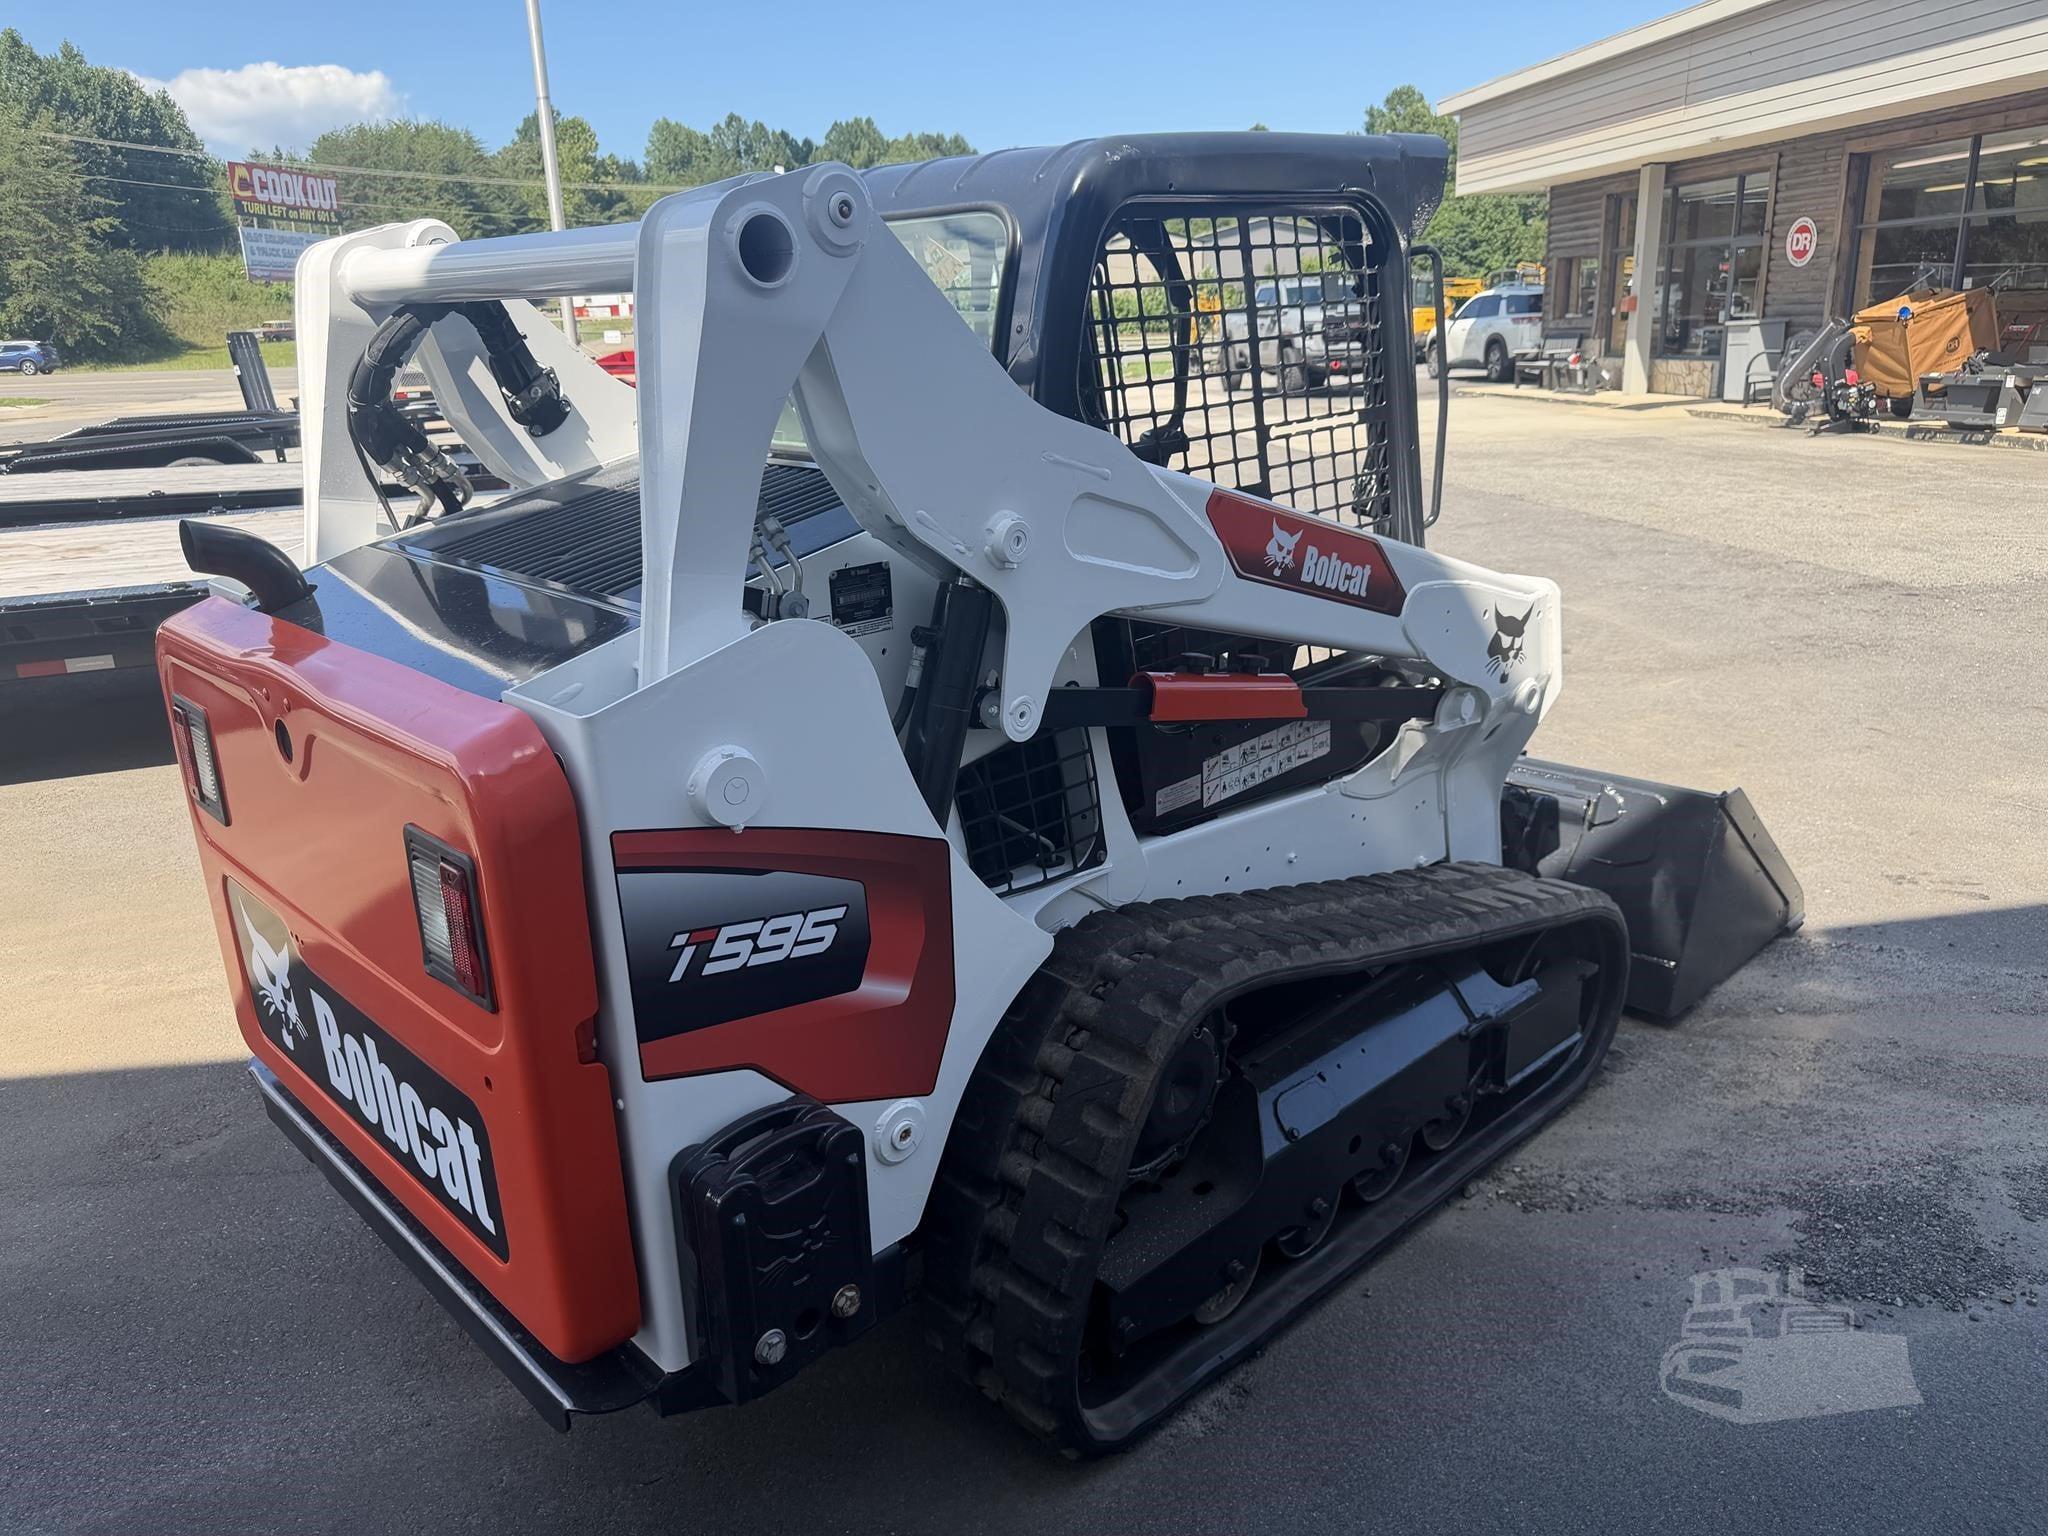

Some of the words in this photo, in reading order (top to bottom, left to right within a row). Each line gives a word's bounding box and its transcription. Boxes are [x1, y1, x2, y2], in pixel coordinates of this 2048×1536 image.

[242, 201, 266, 217] TURN
[268, 204, 287, 218] LEFT
[288, 209, 298, 219] on
[300, 208, 316, 221] HWY
[1791, 233, 1811, 250] DR
[1300, 545, 1372, 598] Bobcat
[668, 906, 848, 983] T595
[309, 988, 497, 1236] Bobcat
